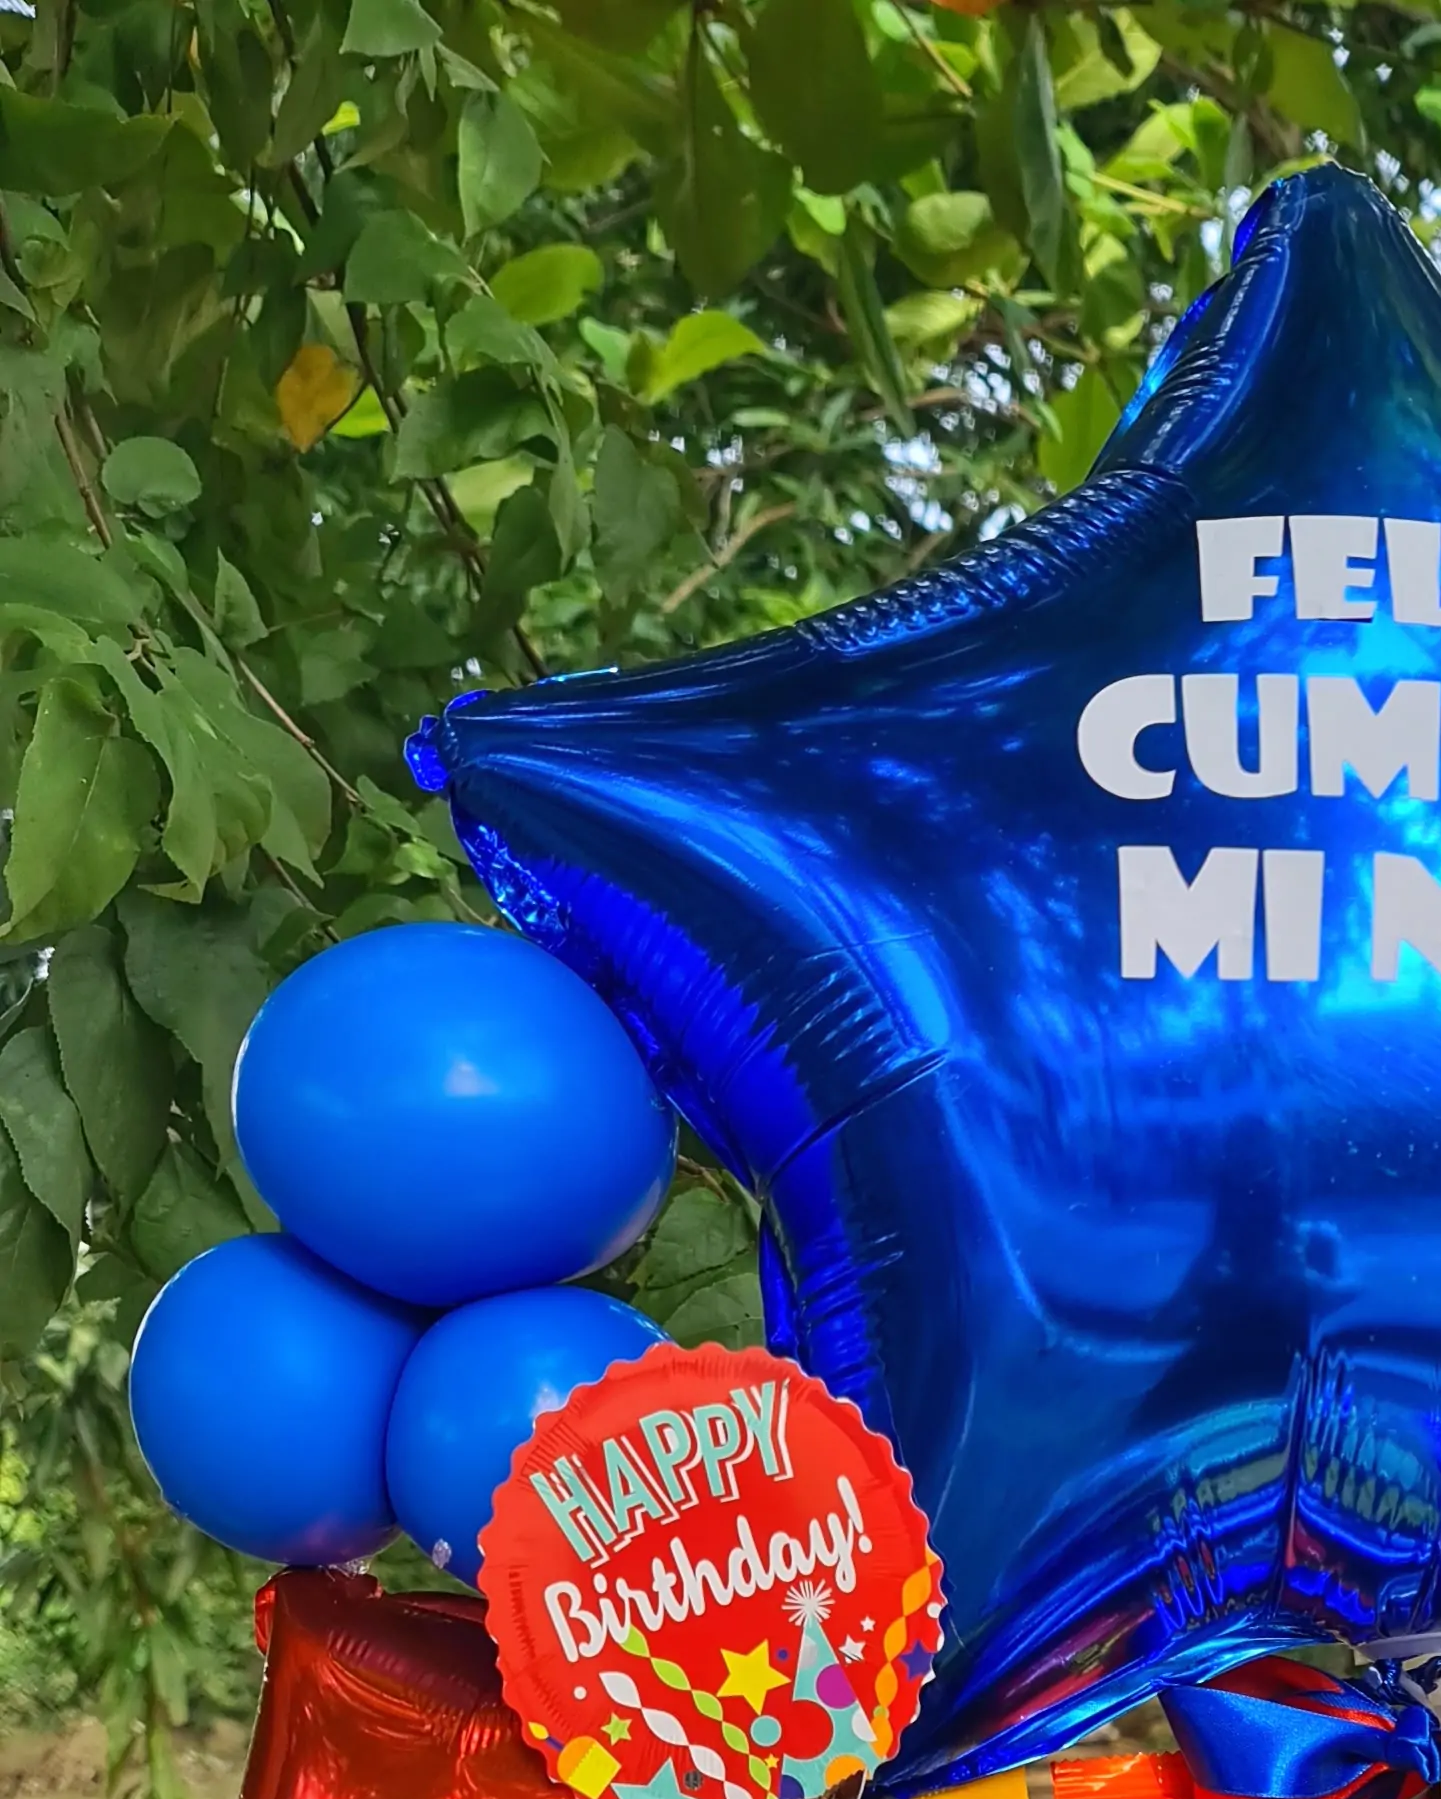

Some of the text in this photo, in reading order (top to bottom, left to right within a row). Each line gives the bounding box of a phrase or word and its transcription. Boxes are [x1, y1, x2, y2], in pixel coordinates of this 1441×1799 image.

[1117, 846, 1325, 982] MI
[530, 1379, 794, 1568] HAPPY
[544, 1475, 873, 1662] Birthday!
